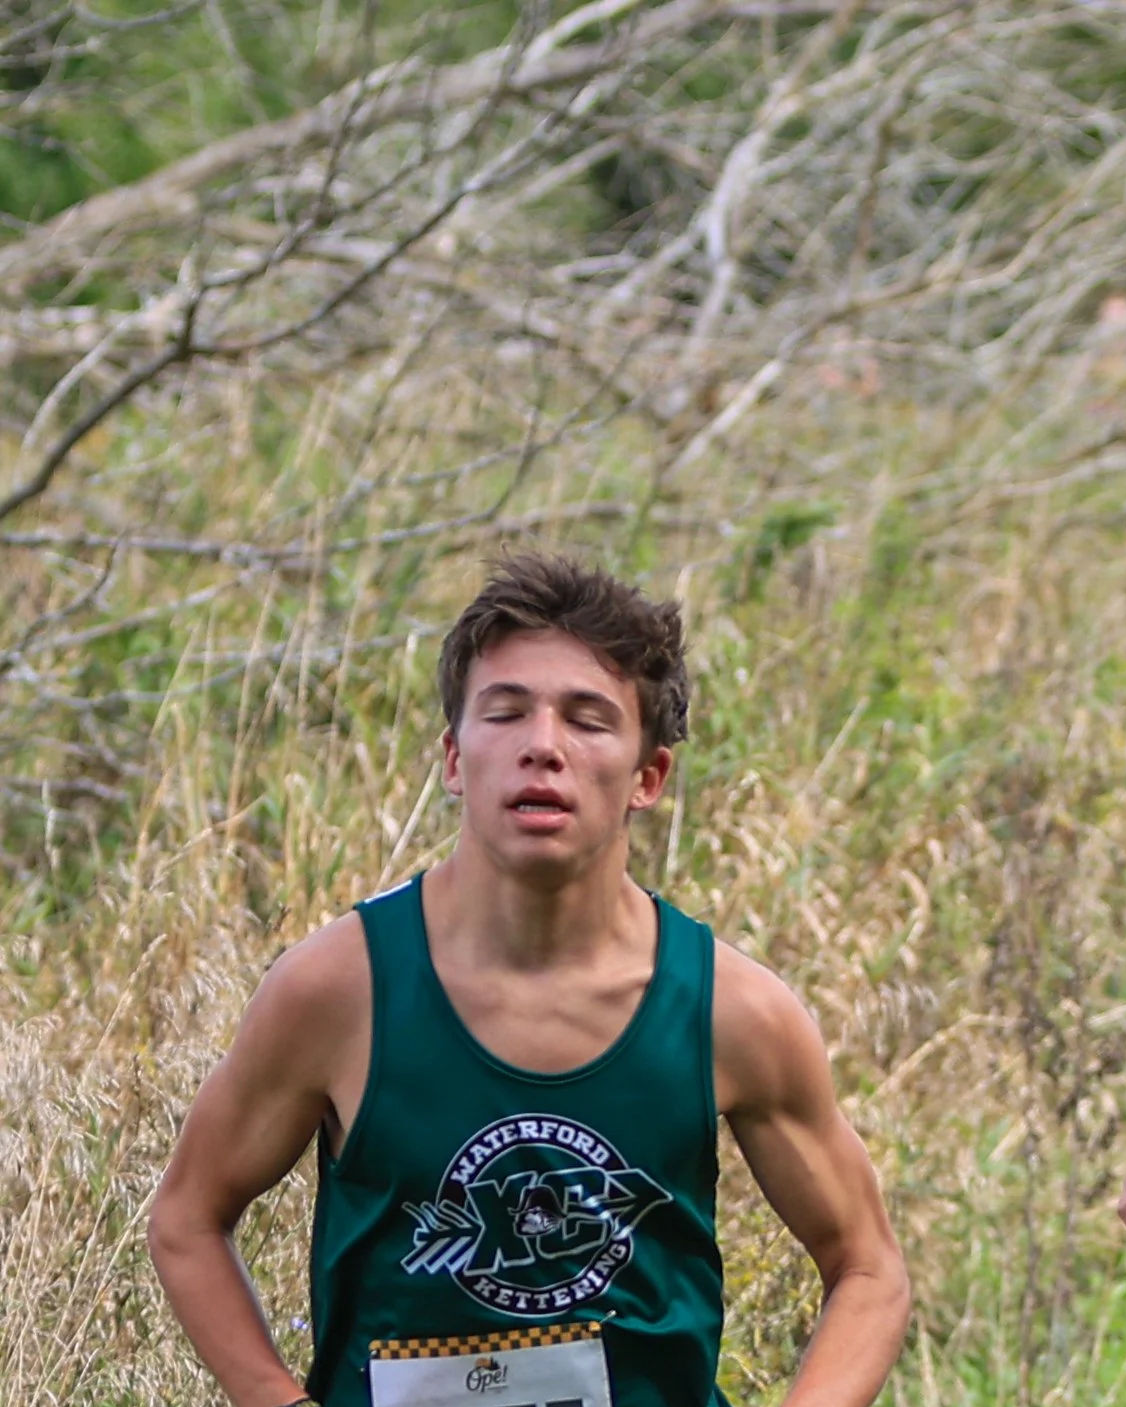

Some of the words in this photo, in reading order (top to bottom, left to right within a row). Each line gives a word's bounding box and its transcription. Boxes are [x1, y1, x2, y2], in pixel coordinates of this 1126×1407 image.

[450, 1120, 611, 1185] WATERFORD
[462, 1166, 610, 1276] XC
[472, 1243, 629, 1309] KETTERING
[466, 1364, 508, 1393] Ope!
